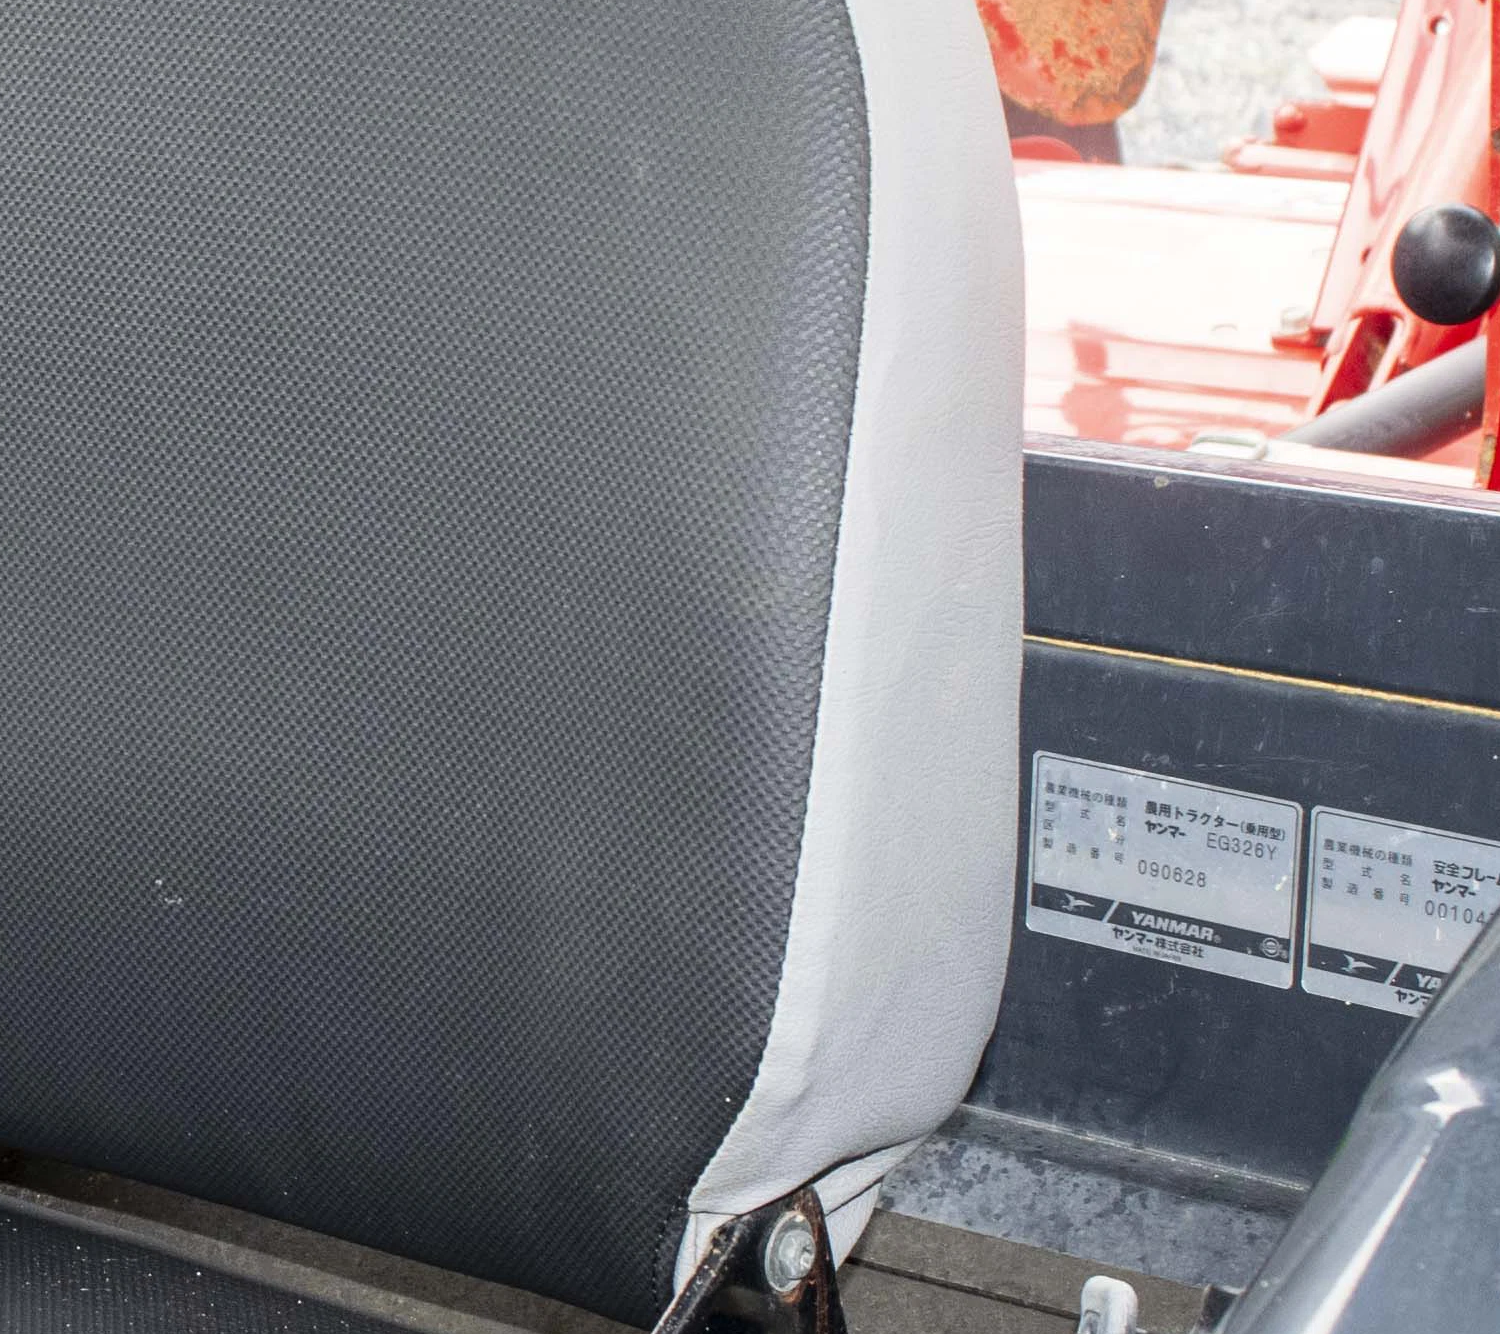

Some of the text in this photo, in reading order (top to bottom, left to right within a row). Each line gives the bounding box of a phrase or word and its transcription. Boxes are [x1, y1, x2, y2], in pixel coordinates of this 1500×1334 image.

[1144, 820, 1187, 839] ヤンマー
[1206, 832, 1278, 861] EG326Y
[1137, 858, 1207, 887] 090628
[1431, 878, 1477, 898] ヤンマー
[1131, 910, 1215, 942] YANMAR
[1424, 899, 1496, 925] 00104
[1111, 925, 1205, 959] ヤンマー株式会社
